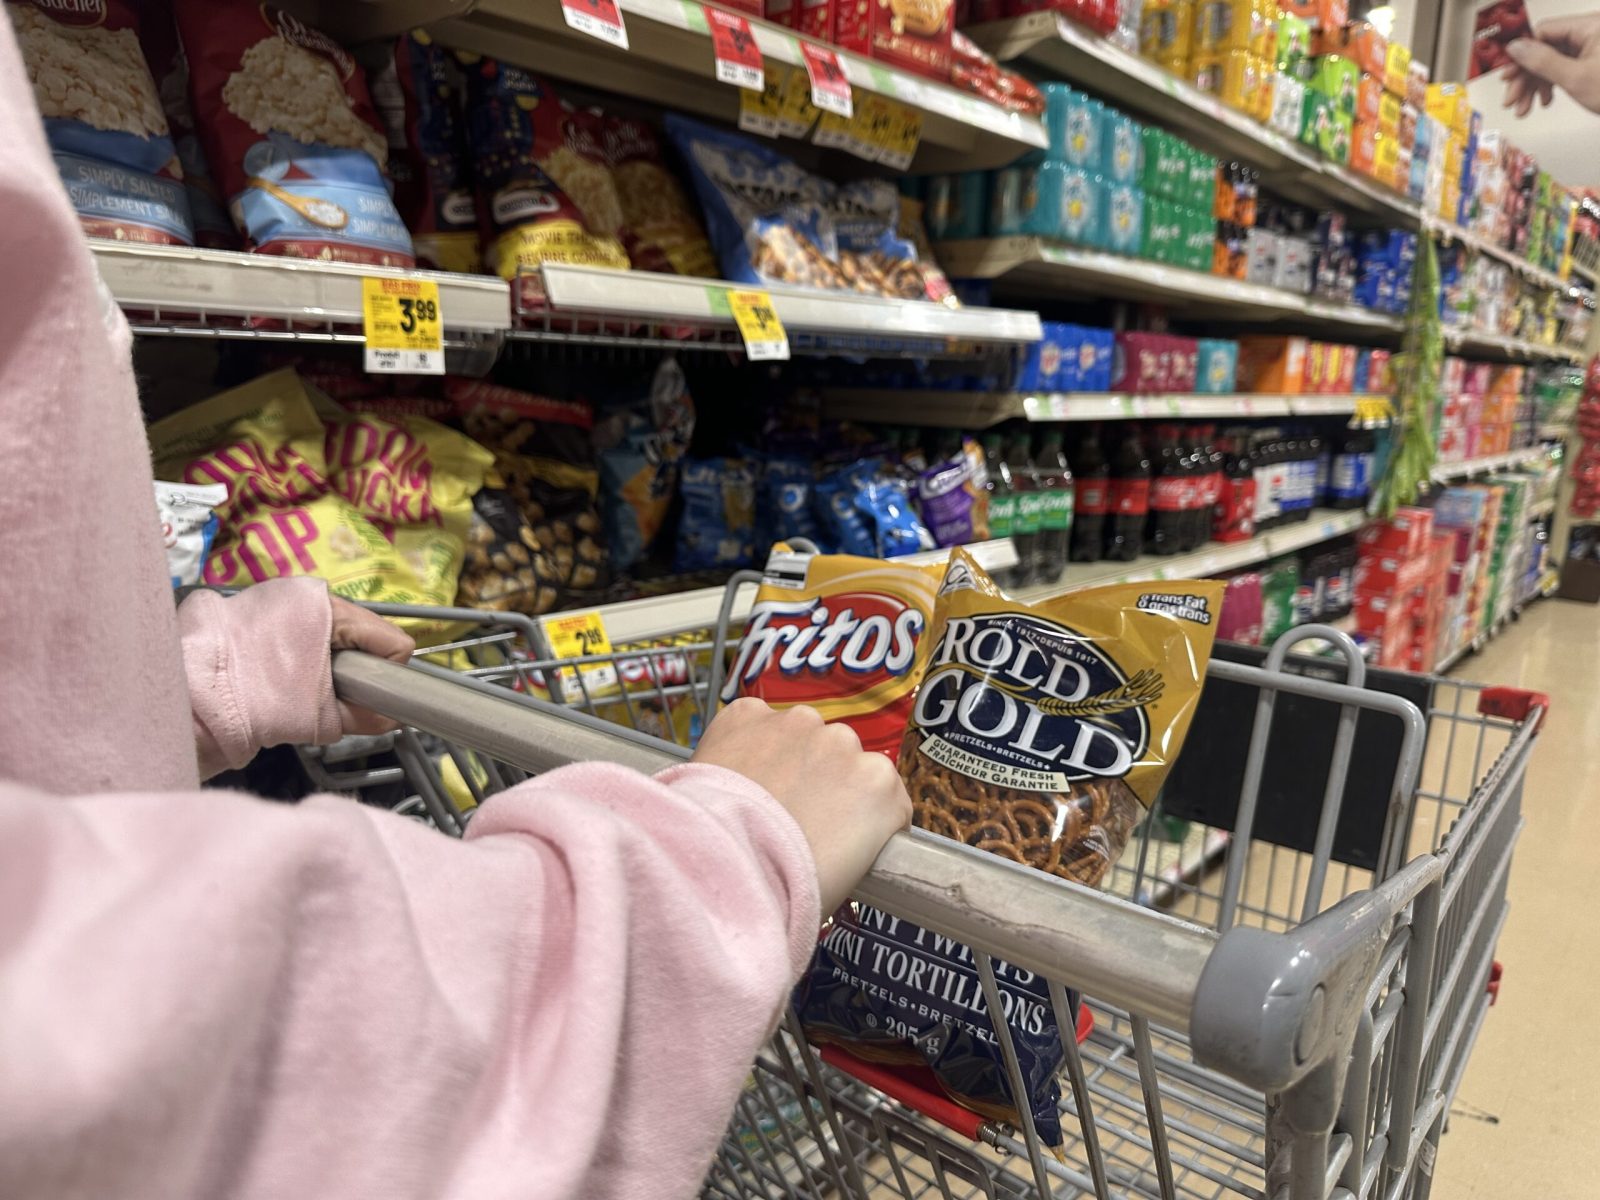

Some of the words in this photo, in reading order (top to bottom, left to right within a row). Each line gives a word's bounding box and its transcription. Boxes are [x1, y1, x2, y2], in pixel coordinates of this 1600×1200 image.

[78, 166, 126, 190] SIMPLY
[70, 187, 156, 216] SIMPLEMENT
[203, 506, 319, 585] POP
[1177, 605, 1210, 624] trans
[1185, 595, 1206, 610] Fat
[720, 597, 924, 702] Fritos
[935, 619, 1091, 703] ROLD
[914, 669, 1134, 777] GOLD
[933, 738, 1007, 773] GUARANTEED
[1011, 768, 1054, 781] FRESH
[949, 732, 993, 750] PRETZELS
[996, 747, 1044, 769] BRETZELS
[991, 773, 1058, 790] GARANTIE
[832, 966, 909, 1009] PRETZELS
[917, 1003, 1000, 1046] BRETZEL
[885, 1015, 920, 1046] 295
[926, 1035, 941, 1056] g
